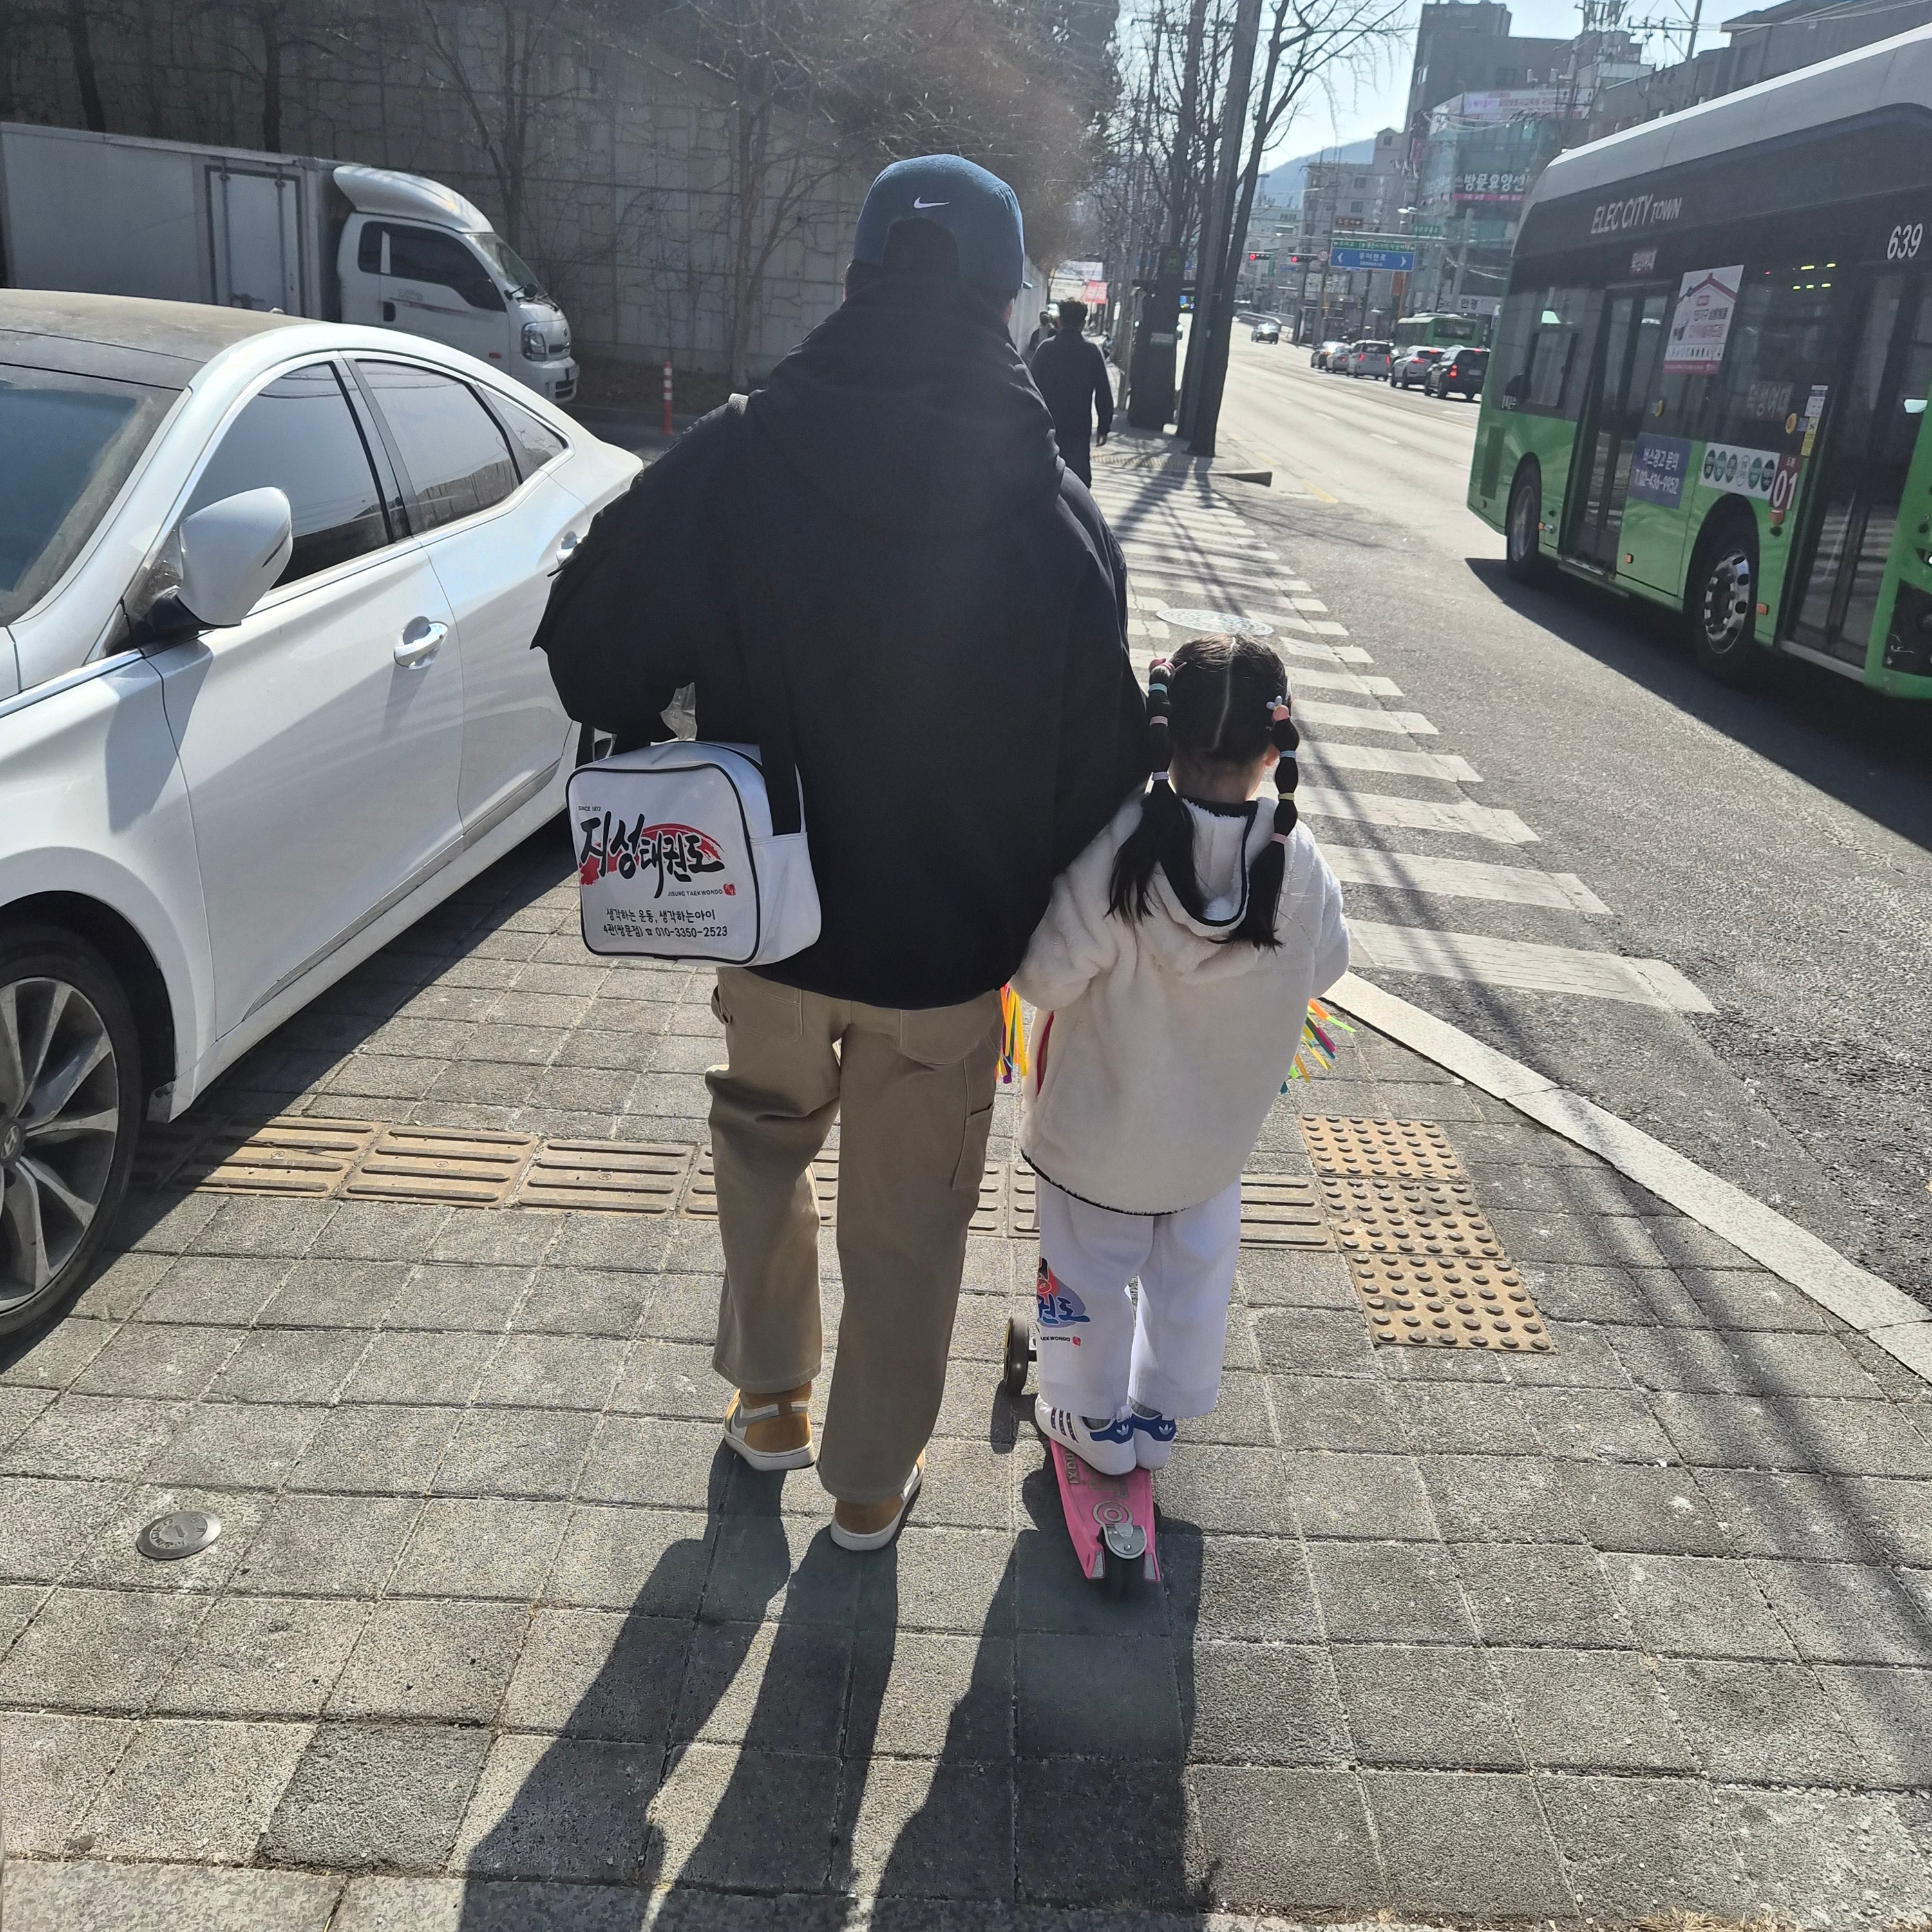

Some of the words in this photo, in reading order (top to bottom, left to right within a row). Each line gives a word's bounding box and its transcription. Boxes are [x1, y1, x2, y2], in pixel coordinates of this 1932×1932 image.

[1464, 172, 1529, 192] 방문요양센
[1591, 201, 1624, 234] ELEC
[1622, 194, 1654, 229] CITY
[1651, 196, 1683, 223] TOWN
[1887, 223, 1923, 260] 639
[1773, 469, 1798, 510] 01
[580, 811, 725, 899] 지성태권도
[607, 908, 636, 922] 생각하는
[639, 909, 658, 923] 운동,
[655, 926, 728, 938] 010-3350-2523
